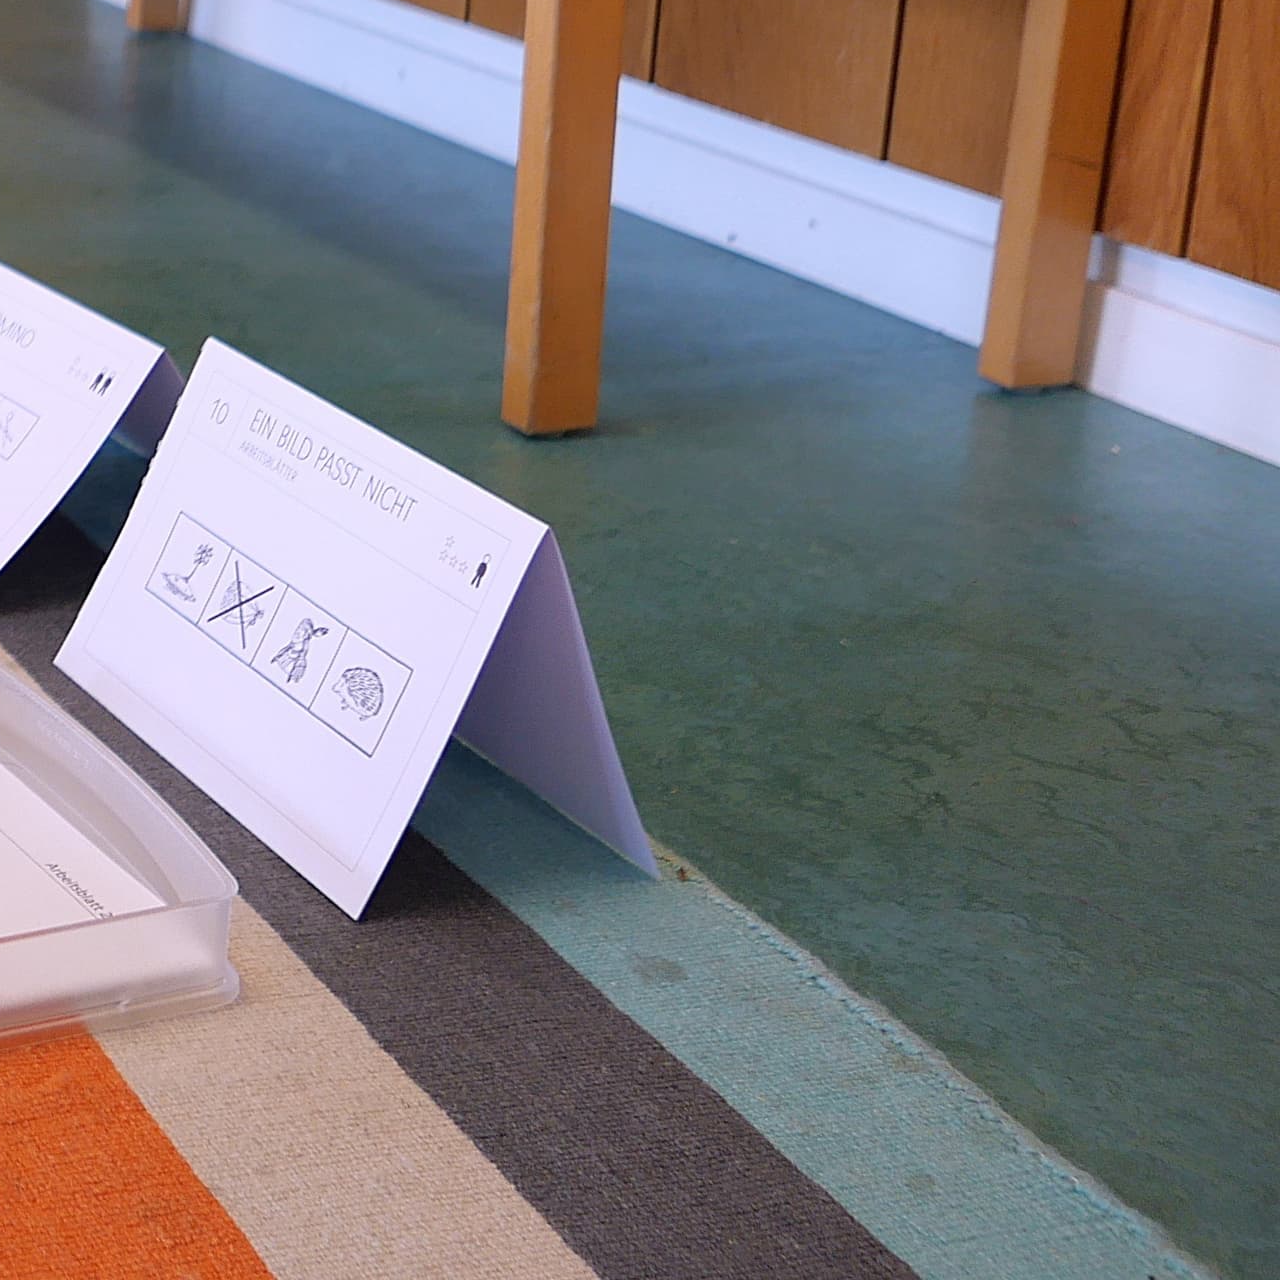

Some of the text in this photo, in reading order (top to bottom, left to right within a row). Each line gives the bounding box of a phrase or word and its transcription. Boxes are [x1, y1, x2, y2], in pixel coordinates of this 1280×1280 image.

[210, 398, 419, 521] 10 EIN BILD PASST NICHT
[44, 863, 105, 912] Arbeitsblatt
